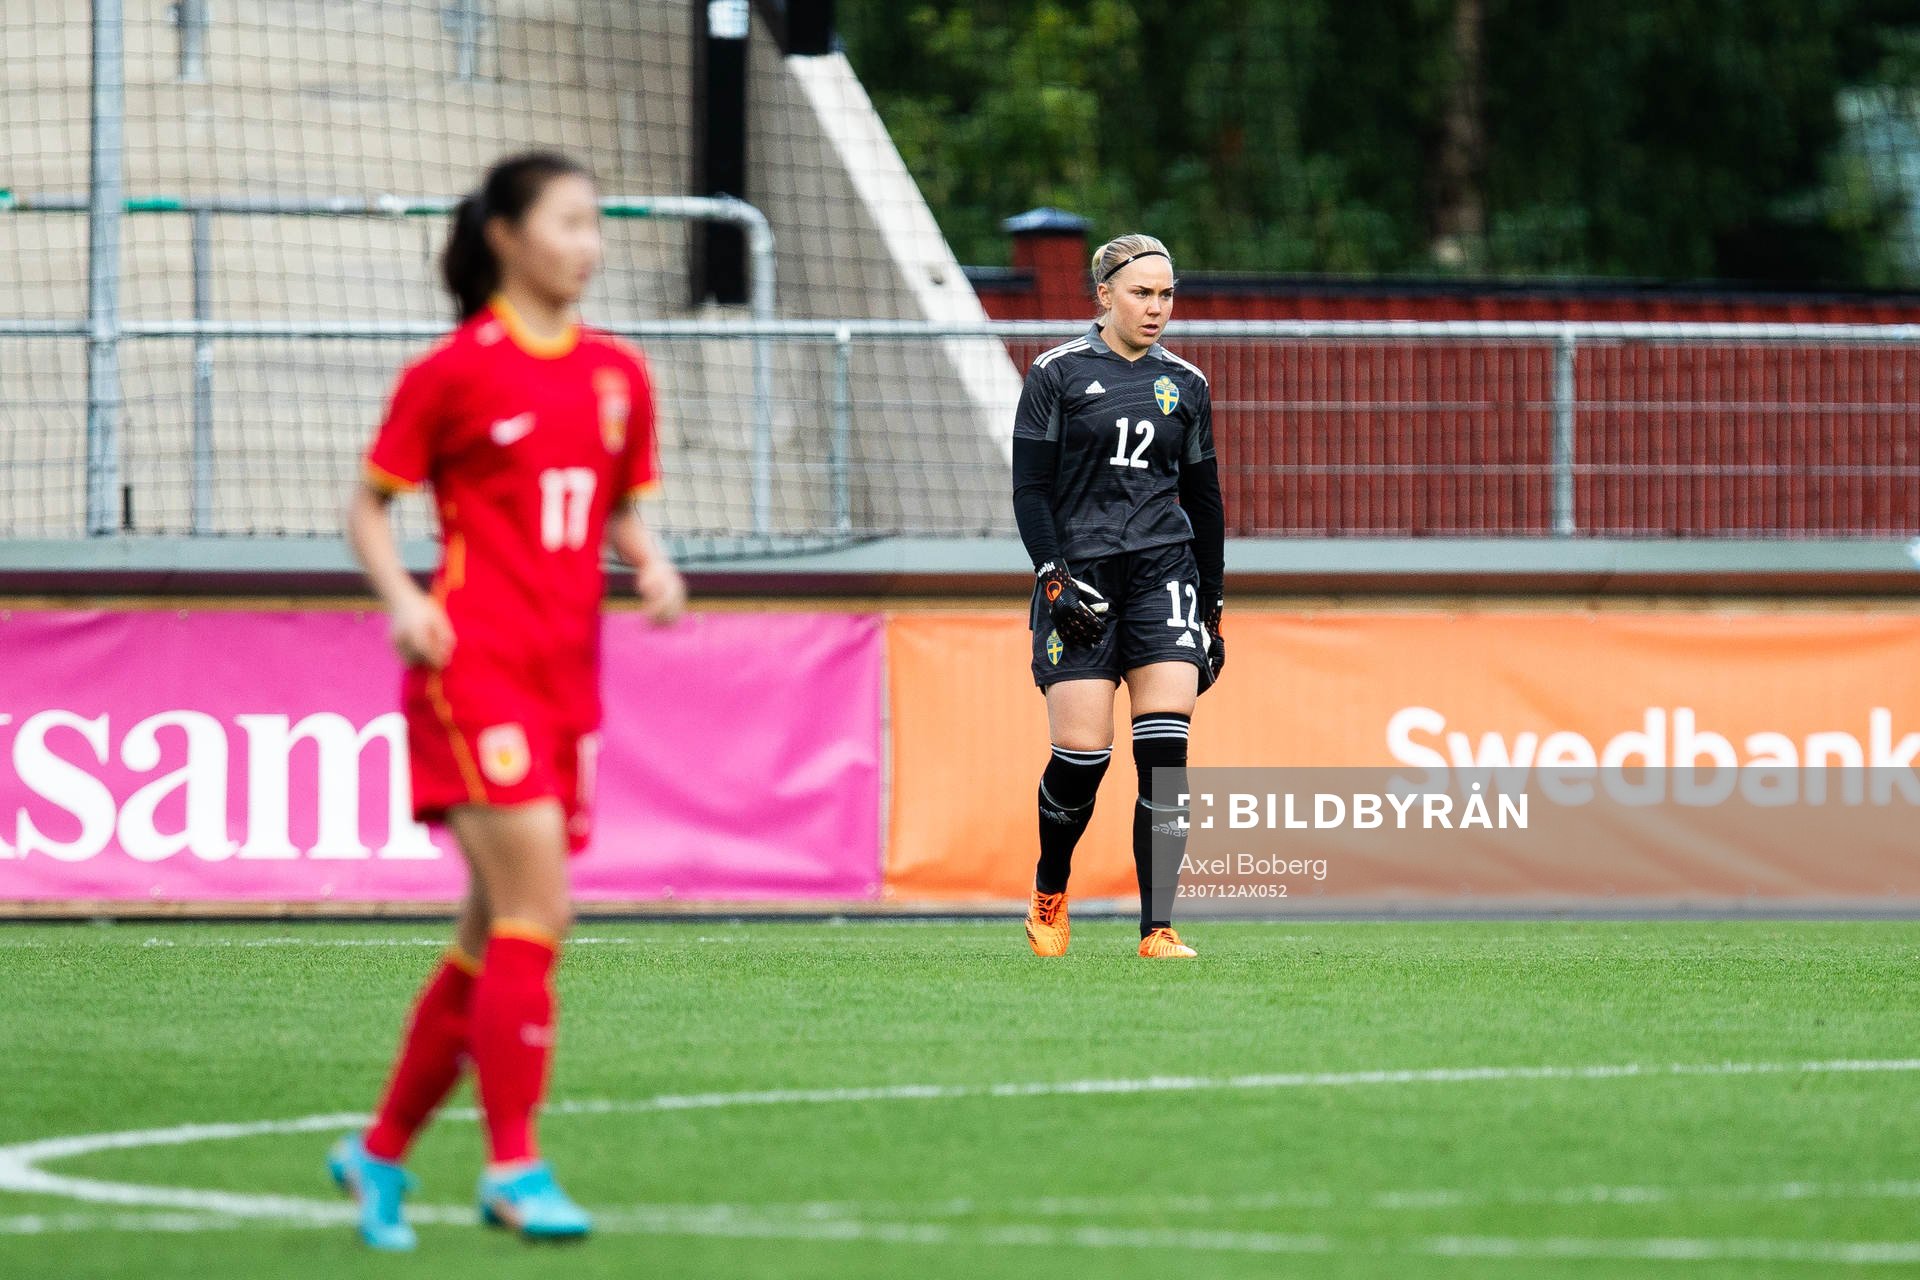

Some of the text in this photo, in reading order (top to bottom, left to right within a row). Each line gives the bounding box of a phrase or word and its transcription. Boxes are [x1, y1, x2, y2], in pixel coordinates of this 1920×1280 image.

[1110, 417, 1155, 469] 12
[539, 466, 597, 552] 17
[1166, 580, 1200, 631] 12
[0, 709, 442, 861] sam
[1386, 706, 1920, 807] Swedbank
